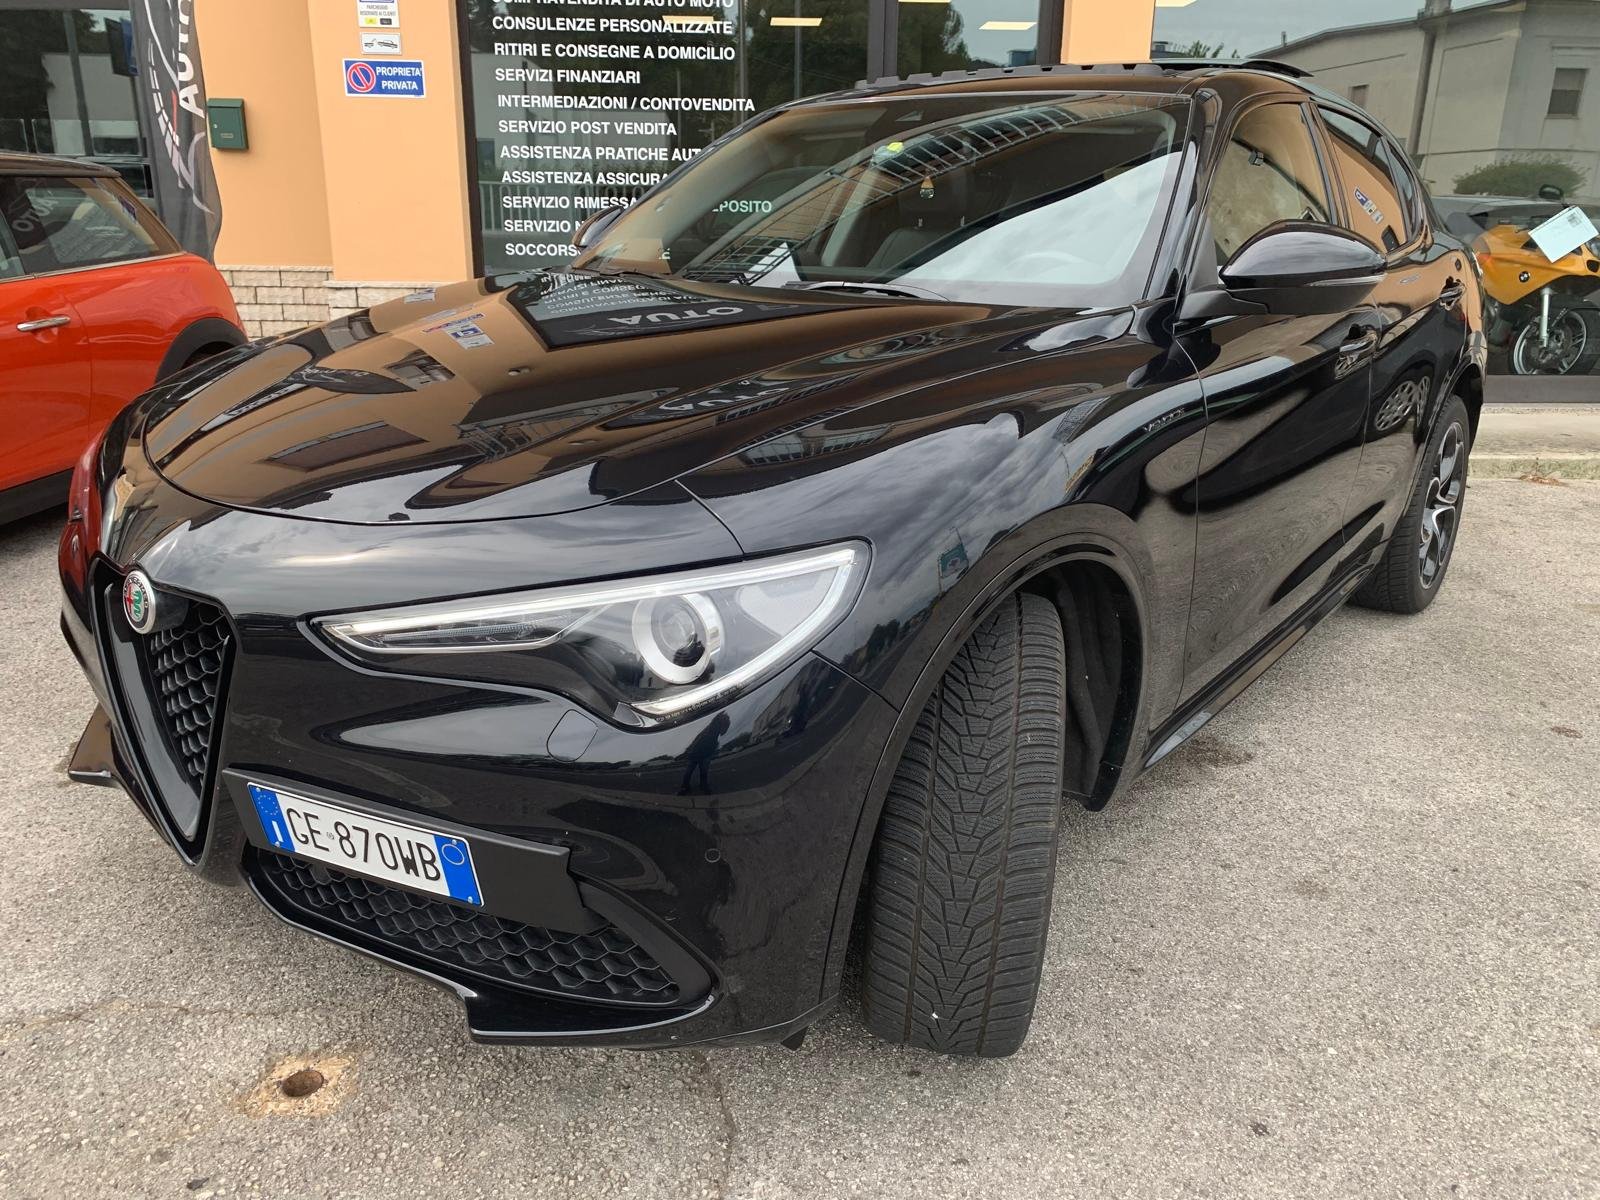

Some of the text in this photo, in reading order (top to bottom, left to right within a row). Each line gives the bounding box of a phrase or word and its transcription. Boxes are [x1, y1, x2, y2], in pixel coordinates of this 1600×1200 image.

[492, 16, 733, 34] CONSULENZE PERSONALIZZATE
[494, 43, 736, 61] RITIRI E CONSEGNE A DOMICILIO
[495, 68, 641, 84] SERVIZI FINANZIARI
[381, 80, 419, 91] PRIVATA
[497, 94, 756, 112] INTERMEDIAZIONI / CONTOVENDITA
[498, 120, 678, 136] SERVIZIO POST VENDITA
[500, 145, 593, 160] ASSISTENZA
[595, 147, 669, 161] PRATICHE
[501, 171, 594, 185] ASSISTENZA
[502, 196, 570, 210] SERVIZIO
[711, 200, 772, 213] POSITO
[504, 220, 571, 234] SERVIZIO
[505, 243, 582, 257] SOCCORS
[286, 806, 330, 853] GE
[333, 820, 442, 882] 870WB
